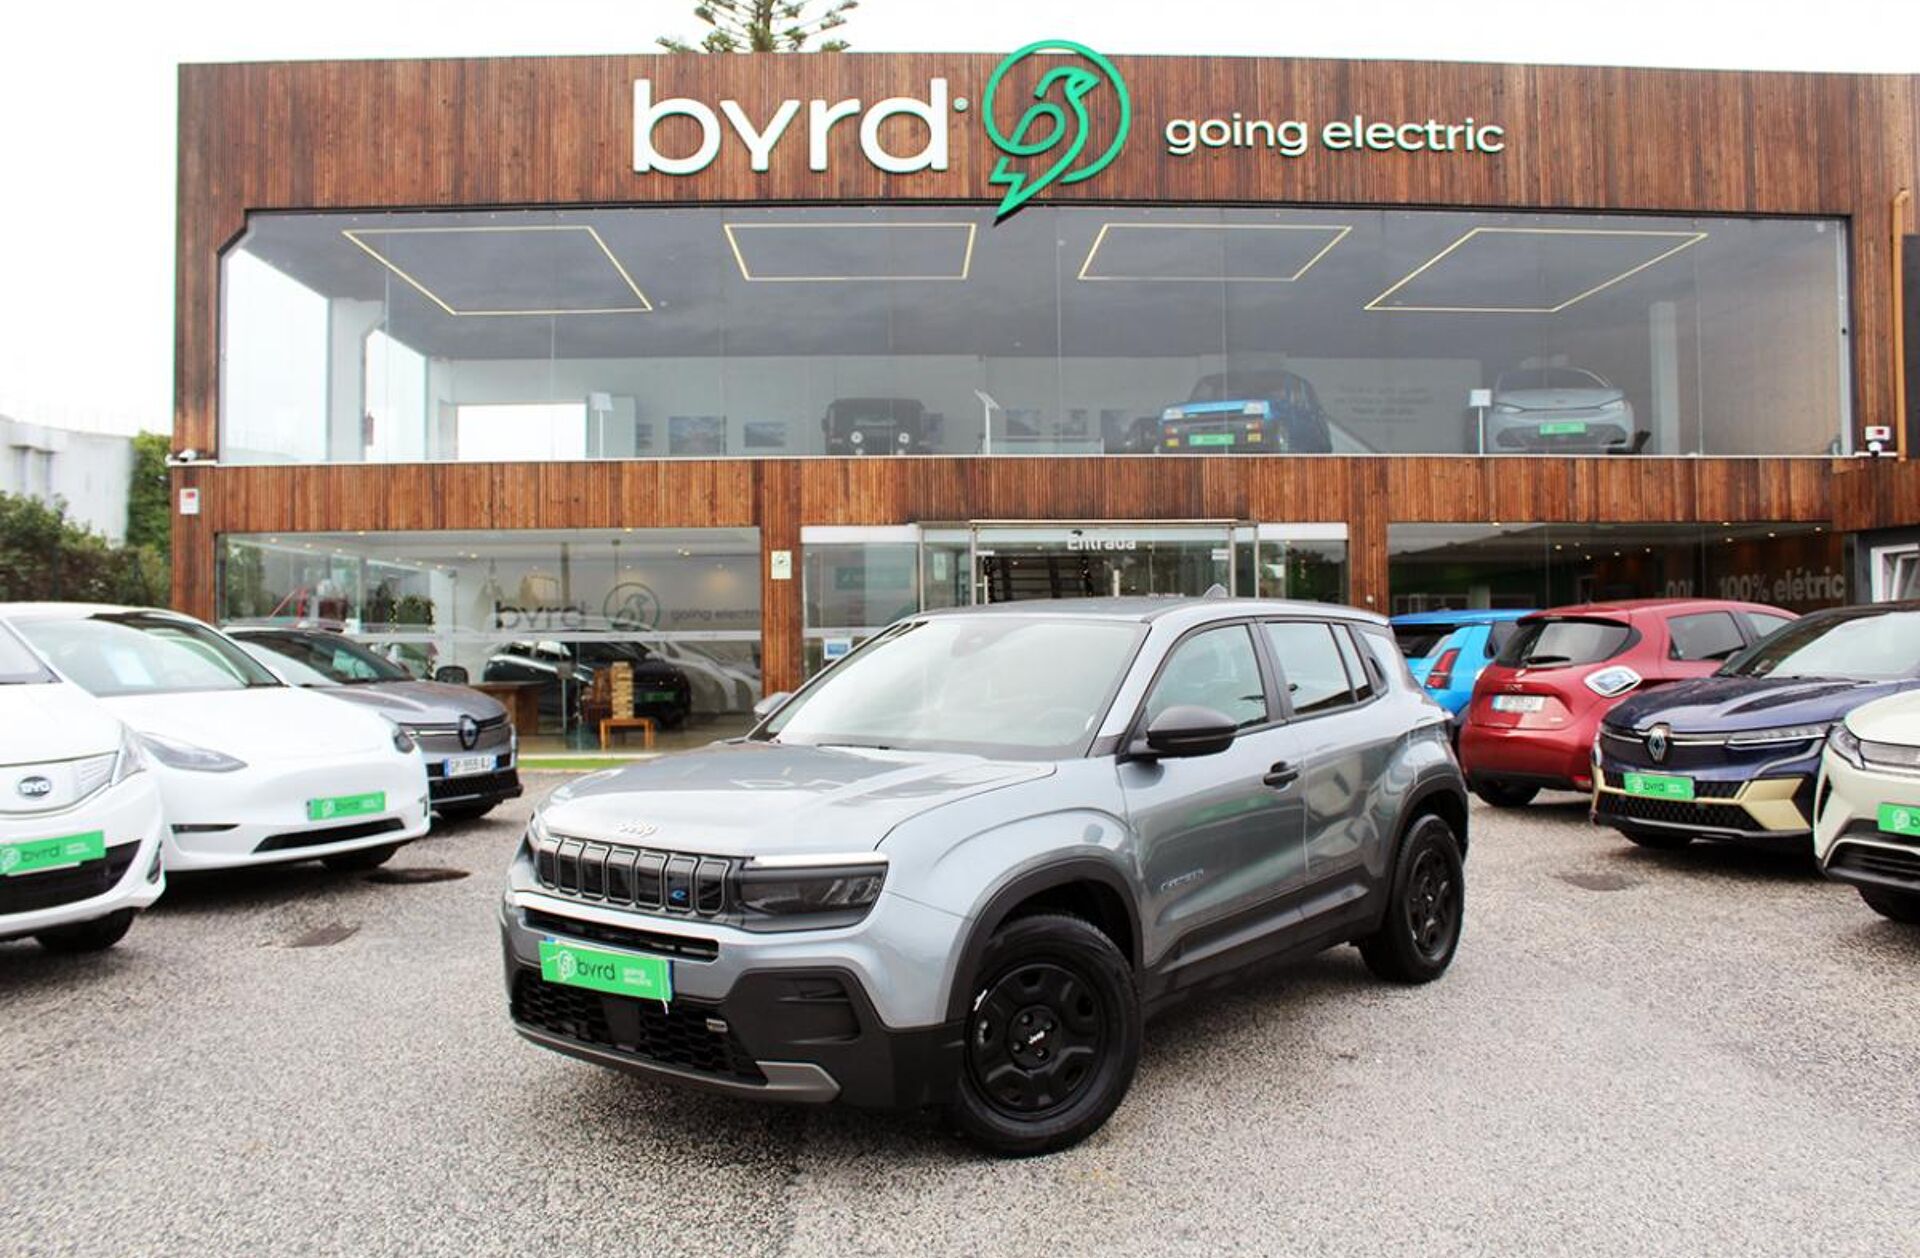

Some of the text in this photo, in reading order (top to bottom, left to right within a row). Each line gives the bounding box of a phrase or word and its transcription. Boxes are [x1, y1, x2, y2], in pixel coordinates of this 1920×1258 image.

[633, 78, 948, 175] byrd
[1165, 112, 1505, 156] going electric
[1067, 534, 1136, 550] Entrada
[1719, 566, 1845, 600] 100% elétric
[495, 601, 586, 629] byrd
[21, 842, 60, 862] byrd
[577, 957, 615, 980] byrd
